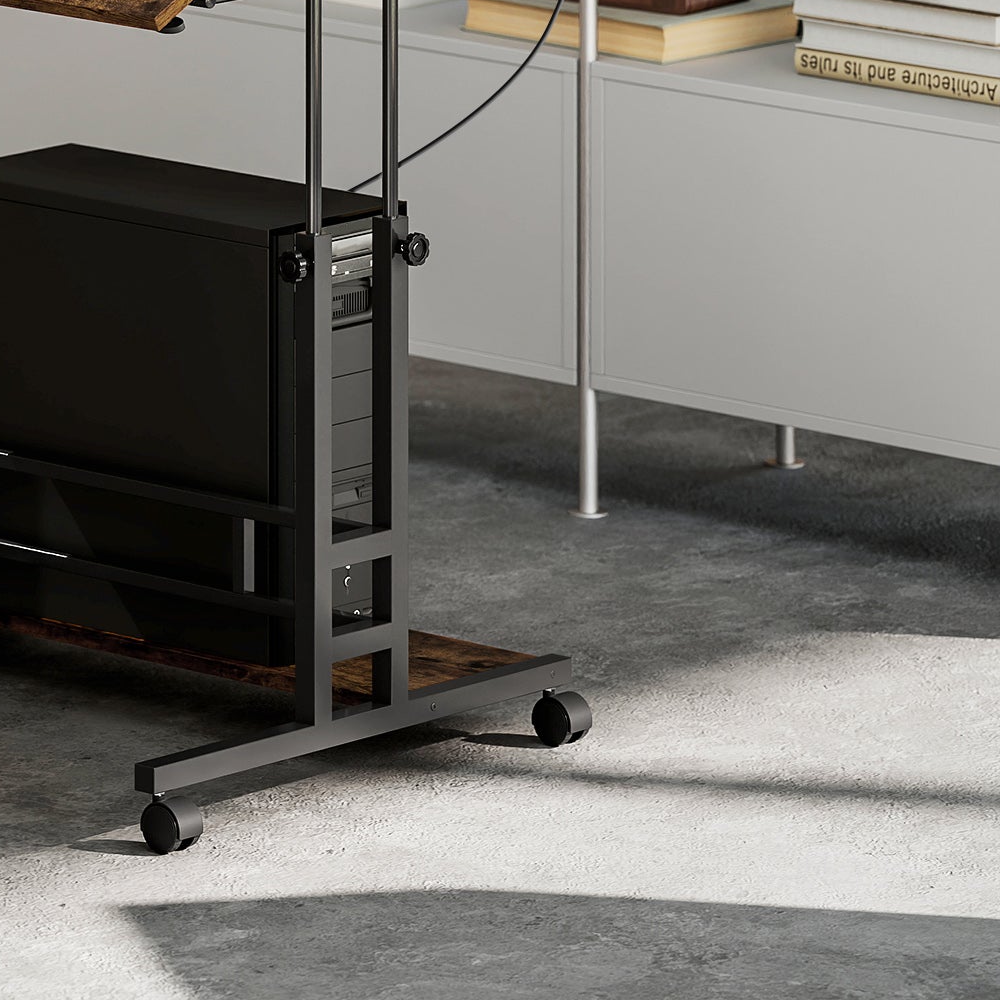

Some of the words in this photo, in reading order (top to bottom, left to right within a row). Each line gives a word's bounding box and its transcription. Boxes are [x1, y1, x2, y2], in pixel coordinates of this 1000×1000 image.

[800, 53, 838, 71] rules
[844, 59, 862, 78] its
[867, 64, 896, 82] and
[901, 69, 999, 101] Architecture
